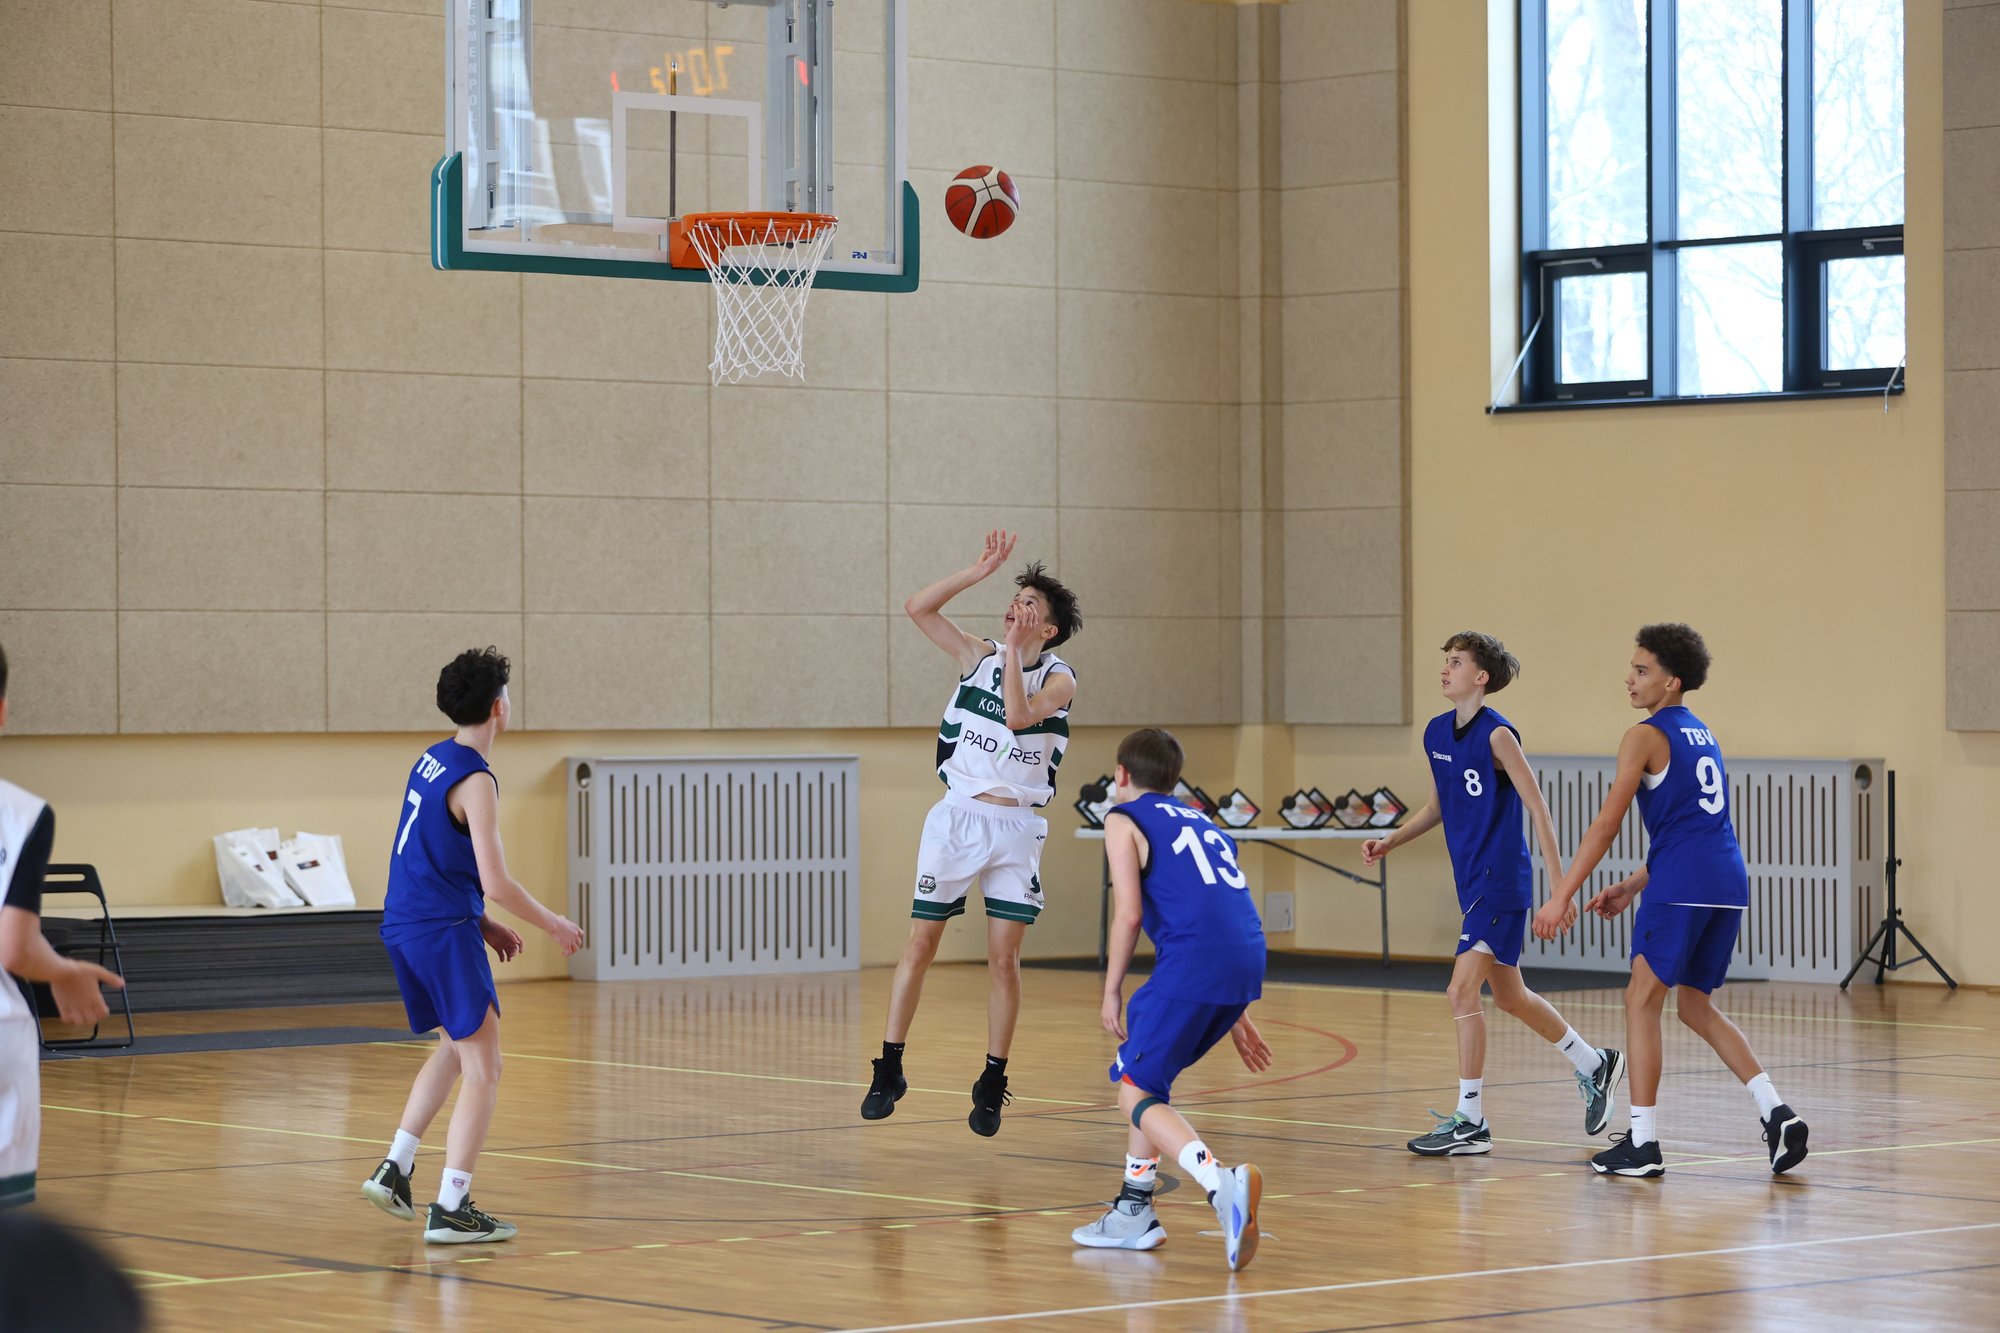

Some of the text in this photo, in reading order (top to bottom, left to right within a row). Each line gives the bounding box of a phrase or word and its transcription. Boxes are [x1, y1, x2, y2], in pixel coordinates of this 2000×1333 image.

[416, 752, 447, 783] TBV
[1463, 768, 1483, 797] 8
[1696, 755, 1725, 815] 9
[397, 788, 423, 856] 7
[1171, 825, 1246, 890] 13
